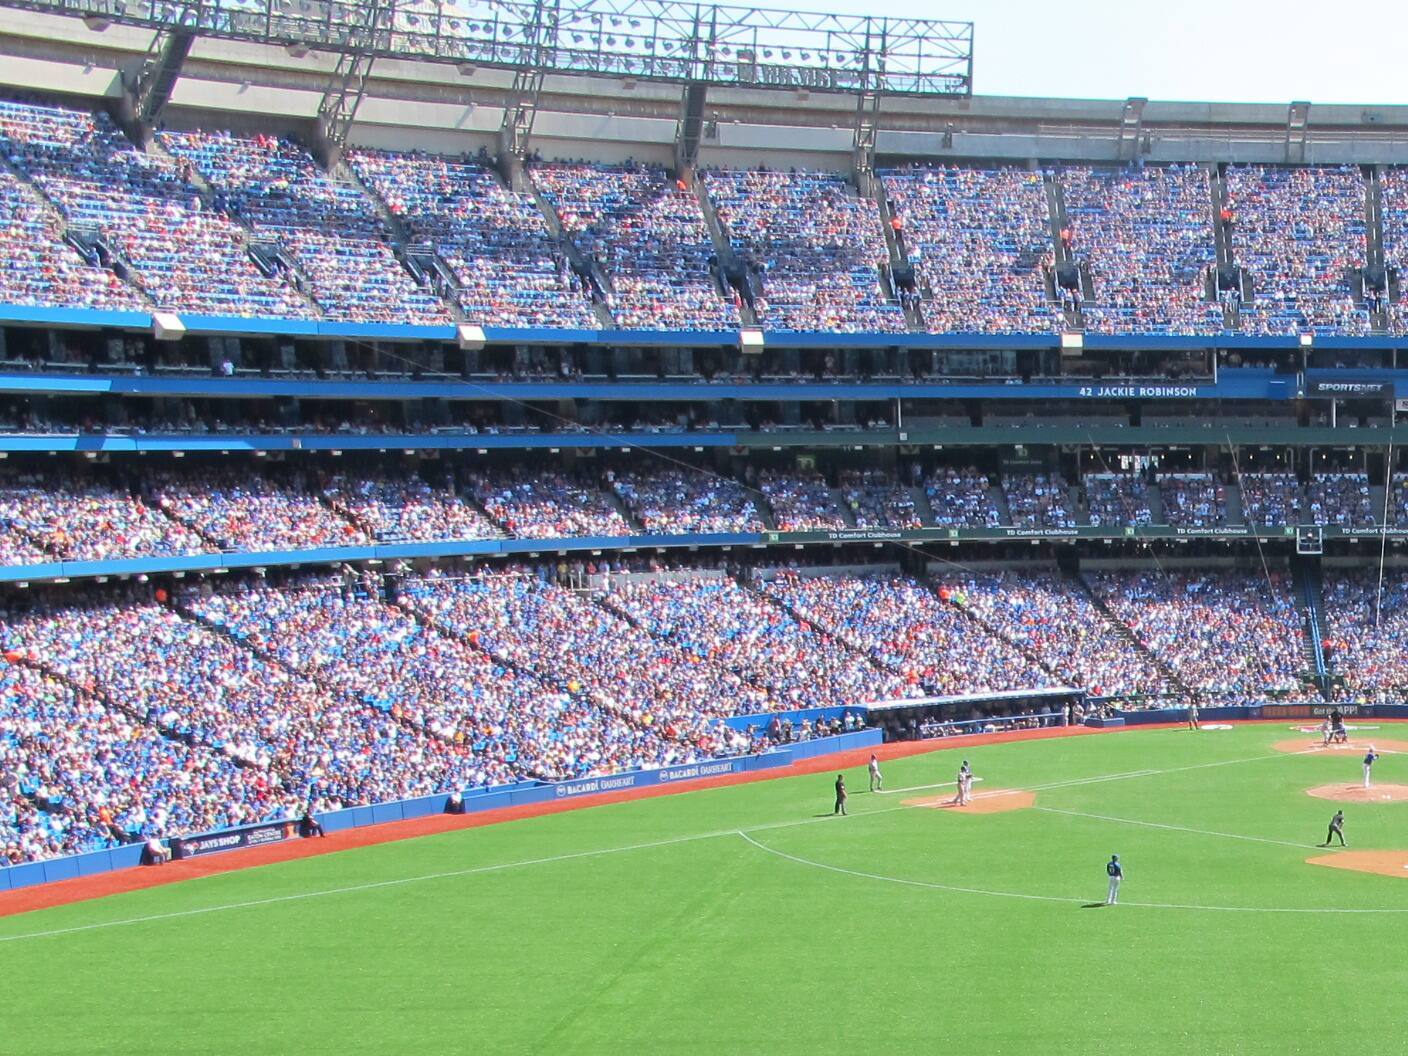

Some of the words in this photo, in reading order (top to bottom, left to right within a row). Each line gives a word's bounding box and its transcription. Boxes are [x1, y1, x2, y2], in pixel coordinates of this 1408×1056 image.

[1079, 387, 1093, 397] 42
[1098, 387, 1135, 397] JACKIE
[1139, 387, 1197, 397] ROBINSON
[1318, 382, 1383, 392] SPORTSNET
[200, 838, 219, 850] JAYS
[219, 835, 241, 846] SHOP
